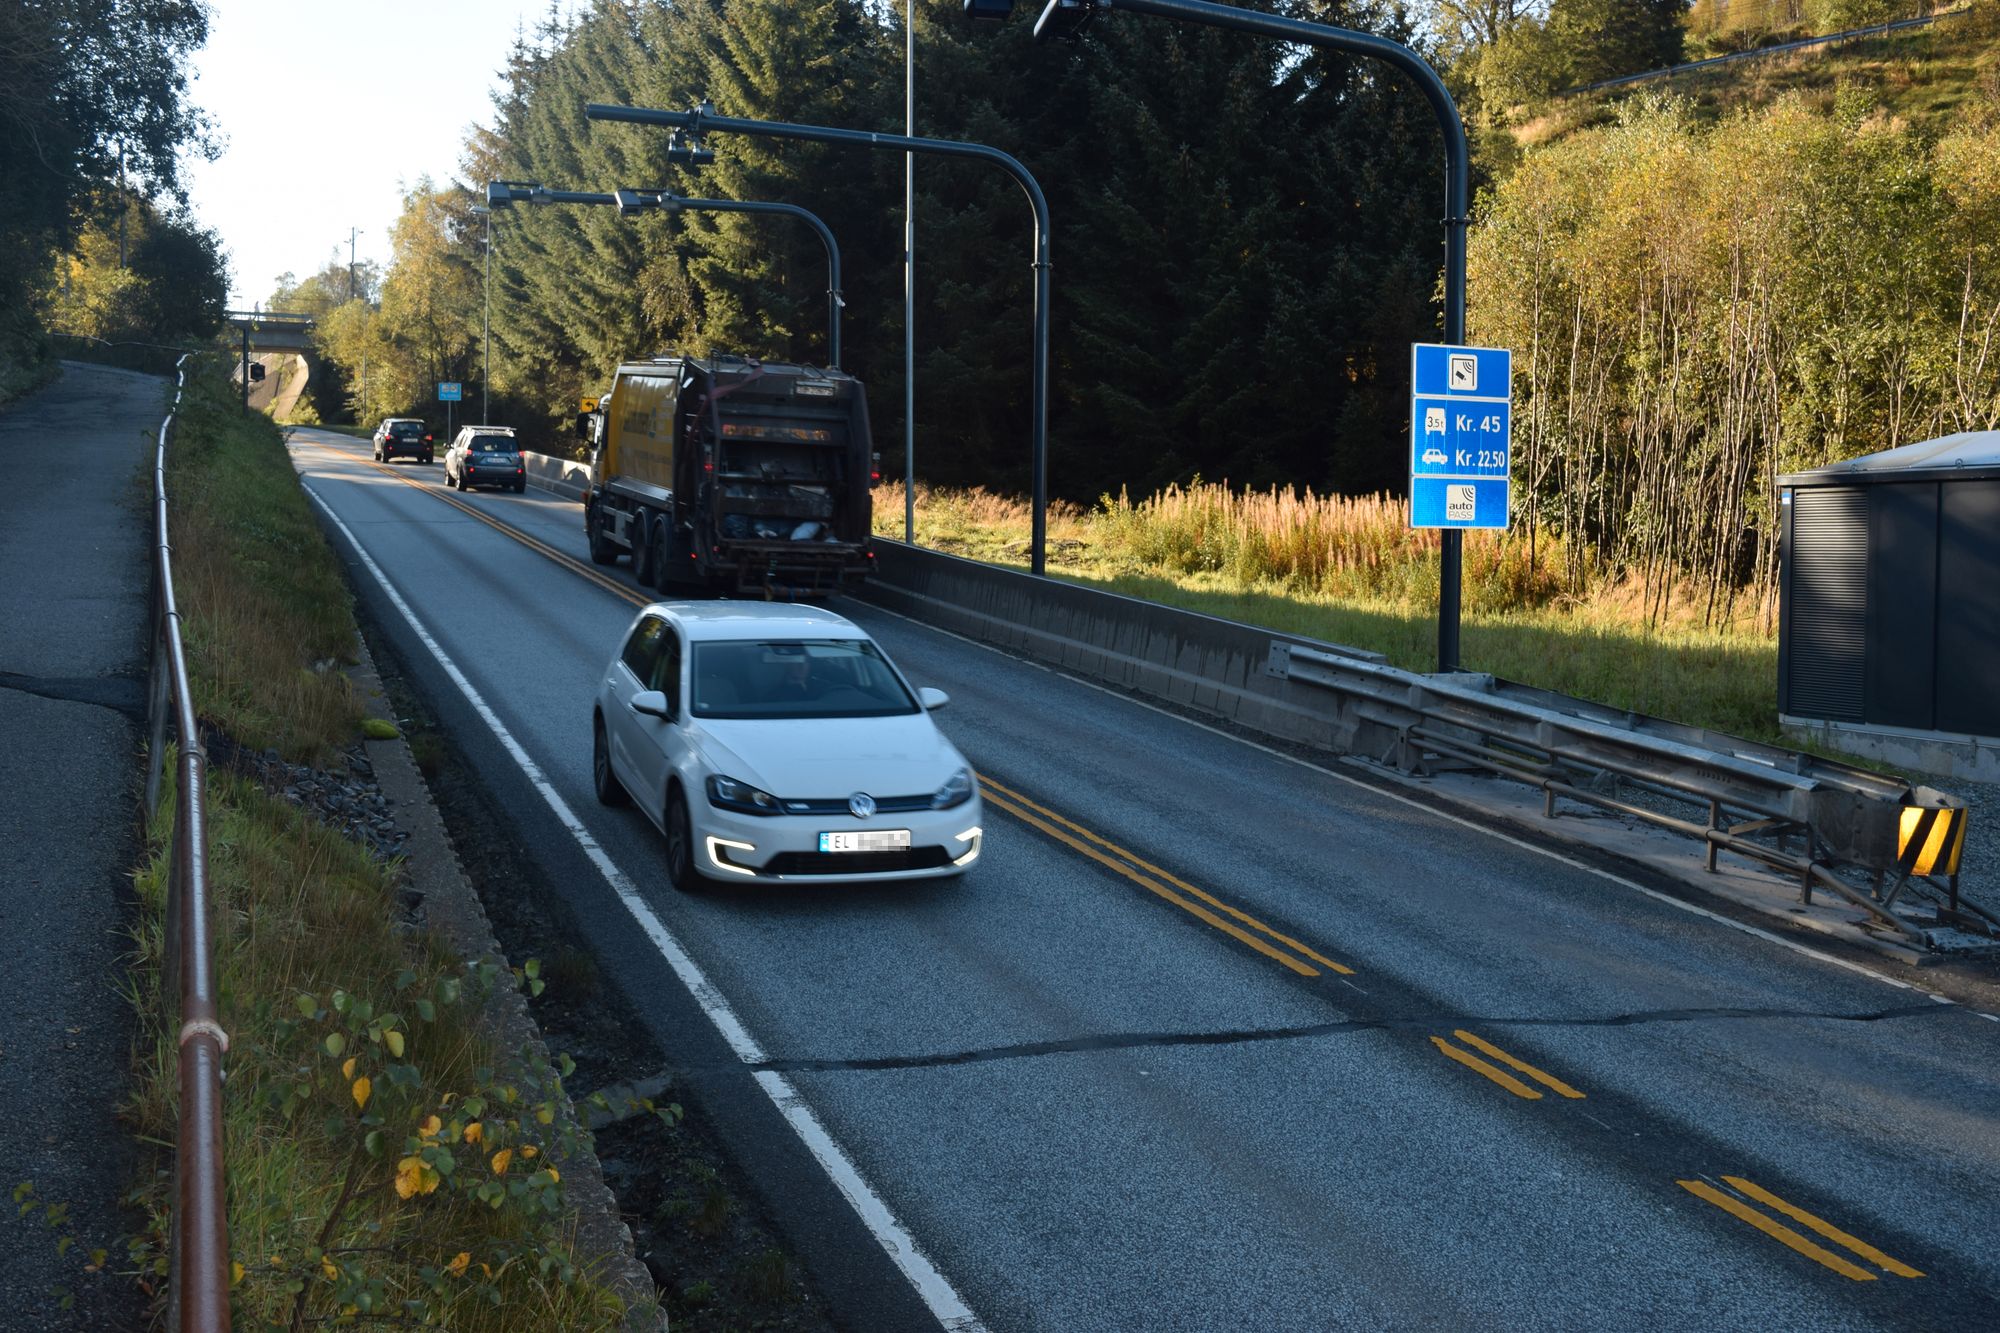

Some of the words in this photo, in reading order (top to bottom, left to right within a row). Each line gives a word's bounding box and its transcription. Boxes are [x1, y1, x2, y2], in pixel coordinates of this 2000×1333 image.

[1456, 414, 1476, 432] Kr.
[1480, 416, 1501, 433] 45
[1455, 449, 1476, 467] Kr.
[1477, 450, 1505, 468] 22,50
[1448, 502, 1473, 510] auto
[1448, 511, 1473, 520] PASS
[834, 835, 850, 849] EL
